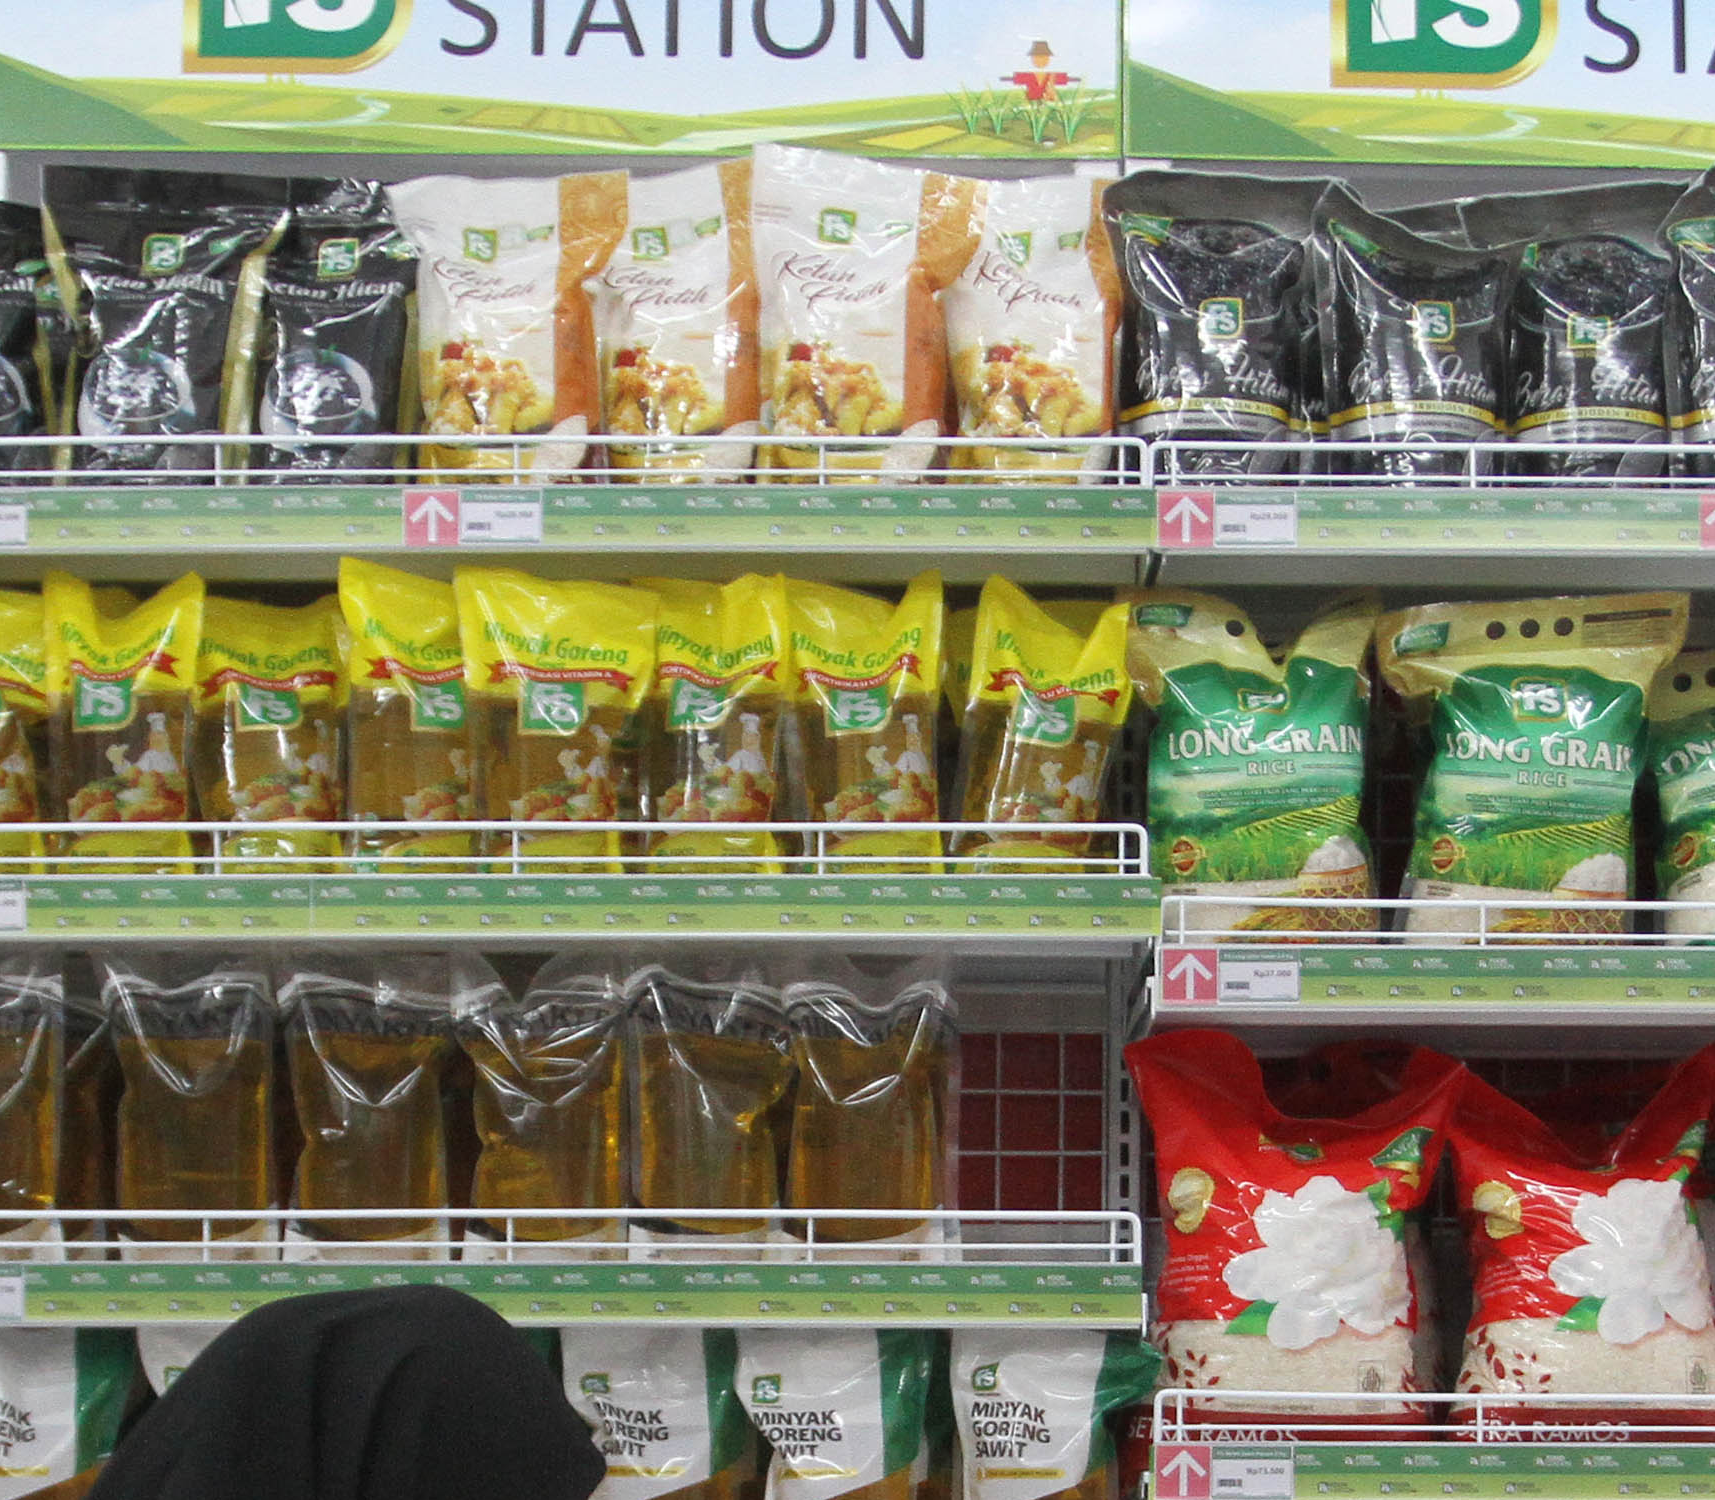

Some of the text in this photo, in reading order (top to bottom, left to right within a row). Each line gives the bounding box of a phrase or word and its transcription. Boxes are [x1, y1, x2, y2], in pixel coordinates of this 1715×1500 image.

[1167, 723, 1363, 761] LONG GRAIN
[1445, 731, 1532, 765] LONG
[1245, 758, 1296, 776] RICE
[1517, 770, 1568, 788] RICE
[752, 1409, 836, 1427] MINYAK
[971, 1401, 1046, 1425] MINYAK
